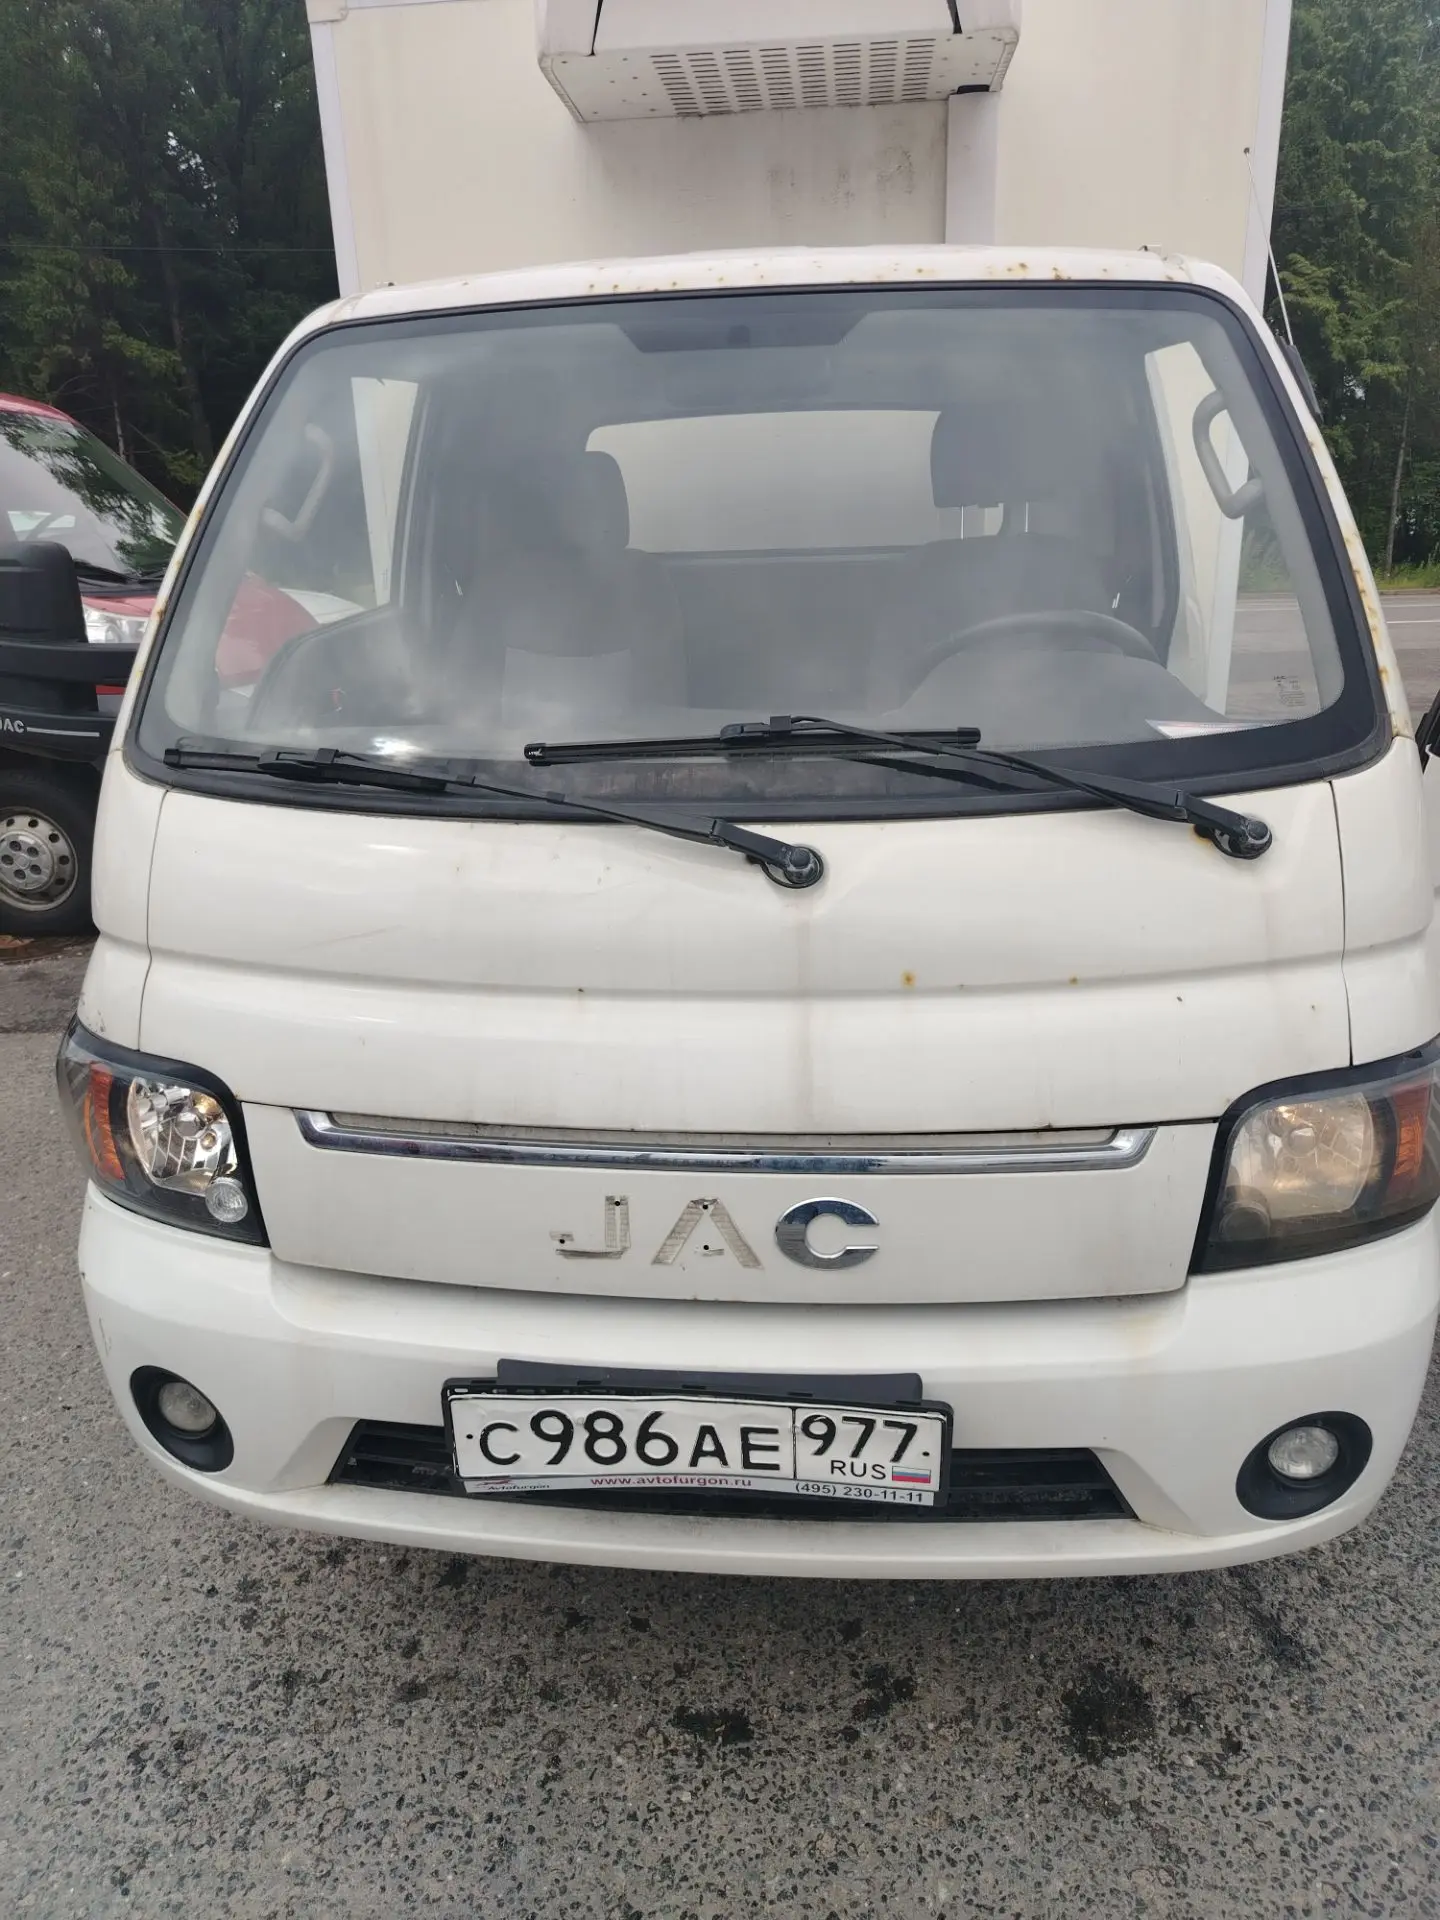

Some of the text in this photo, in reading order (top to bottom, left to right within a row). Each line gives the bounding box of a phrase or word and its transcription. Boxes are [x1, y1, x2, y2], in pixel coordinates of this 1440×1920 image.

[801, 1414, 919, 1463] 977
[830, 1459, 887, 1481] RUS
[590, 1475, 753, 1487] www.avtofurgon.ru
[795, 1482, 924, 1503] (495) 230-11-11
